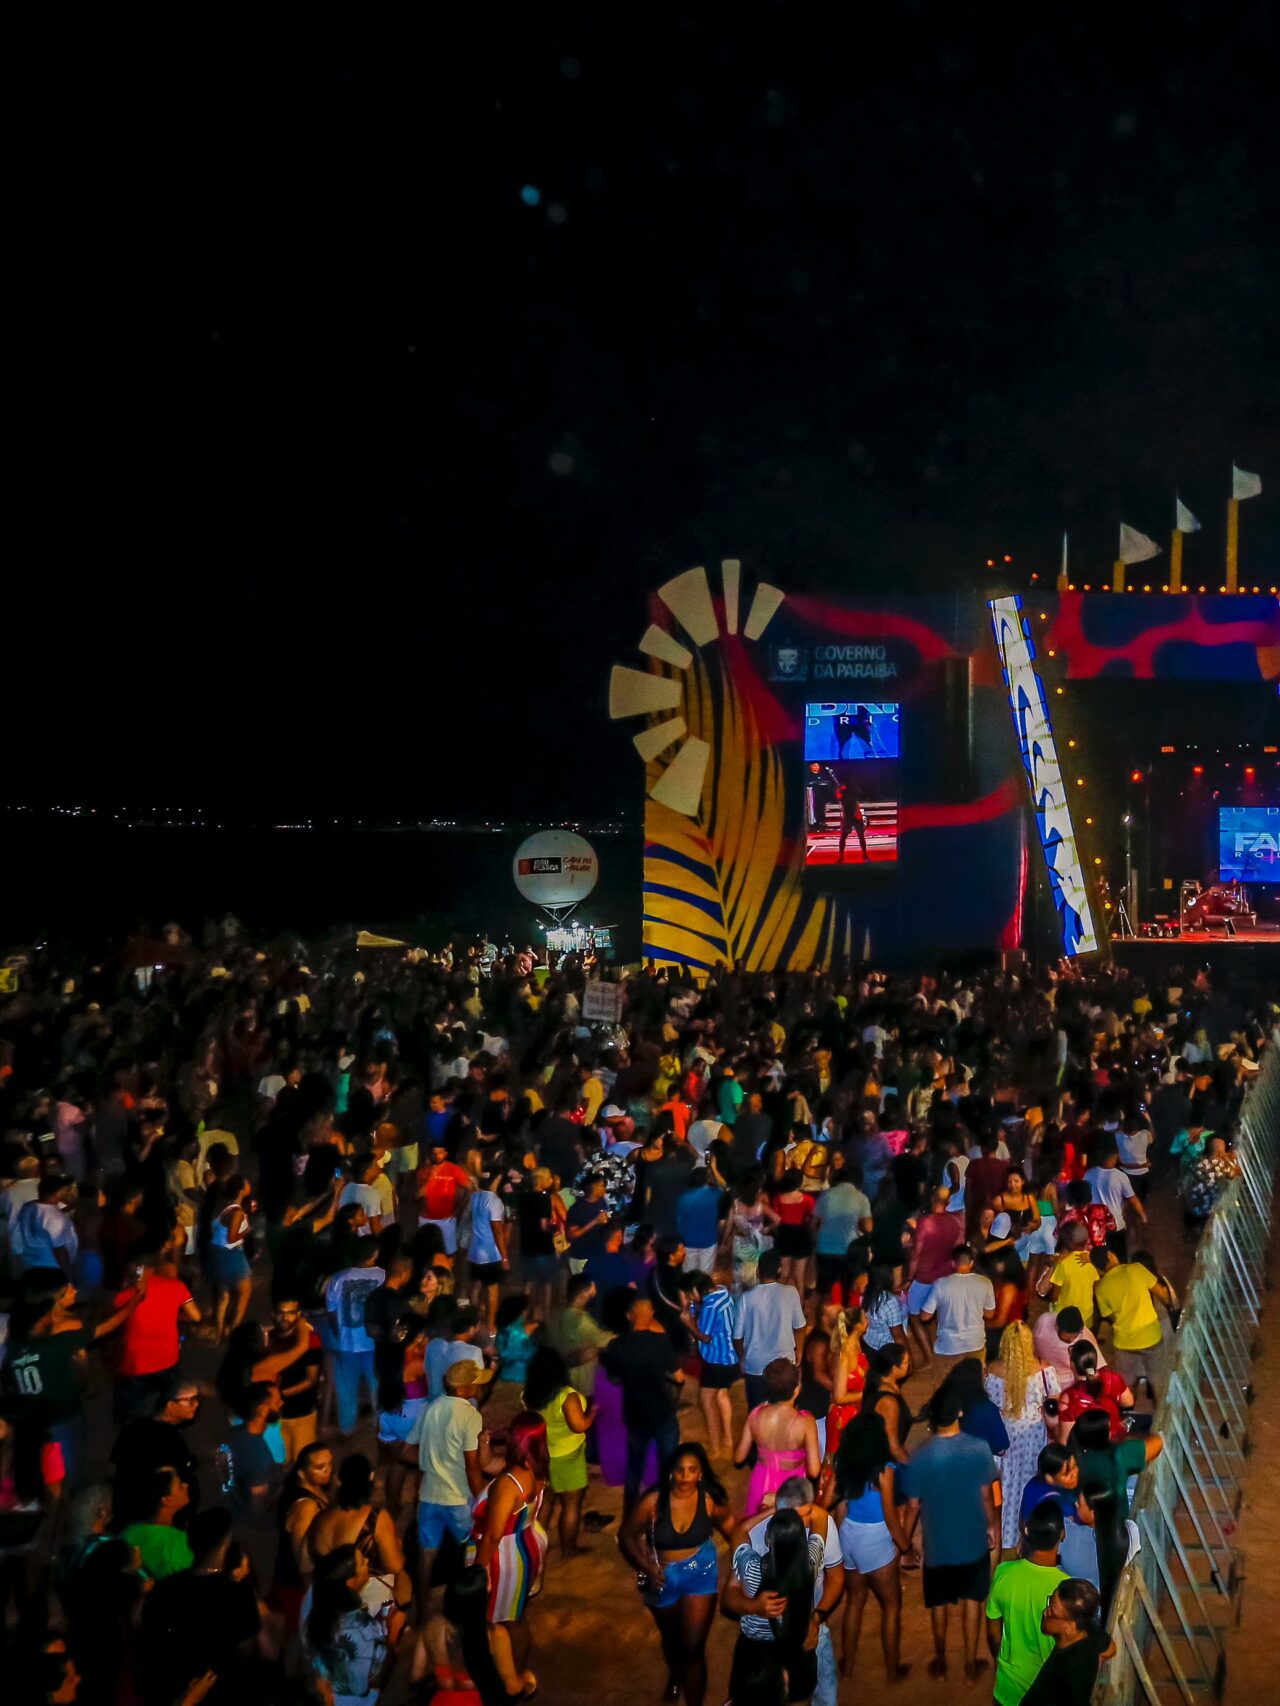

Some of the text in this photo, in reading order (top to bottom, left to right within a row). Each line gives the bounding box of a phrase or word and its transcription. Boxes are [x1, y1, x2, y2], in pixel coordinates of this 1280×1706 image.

[814, 645, 886, 661] GOVERNO
[814, 664, 835, 678] DA
[15, 1365, 43, 1395] 10
